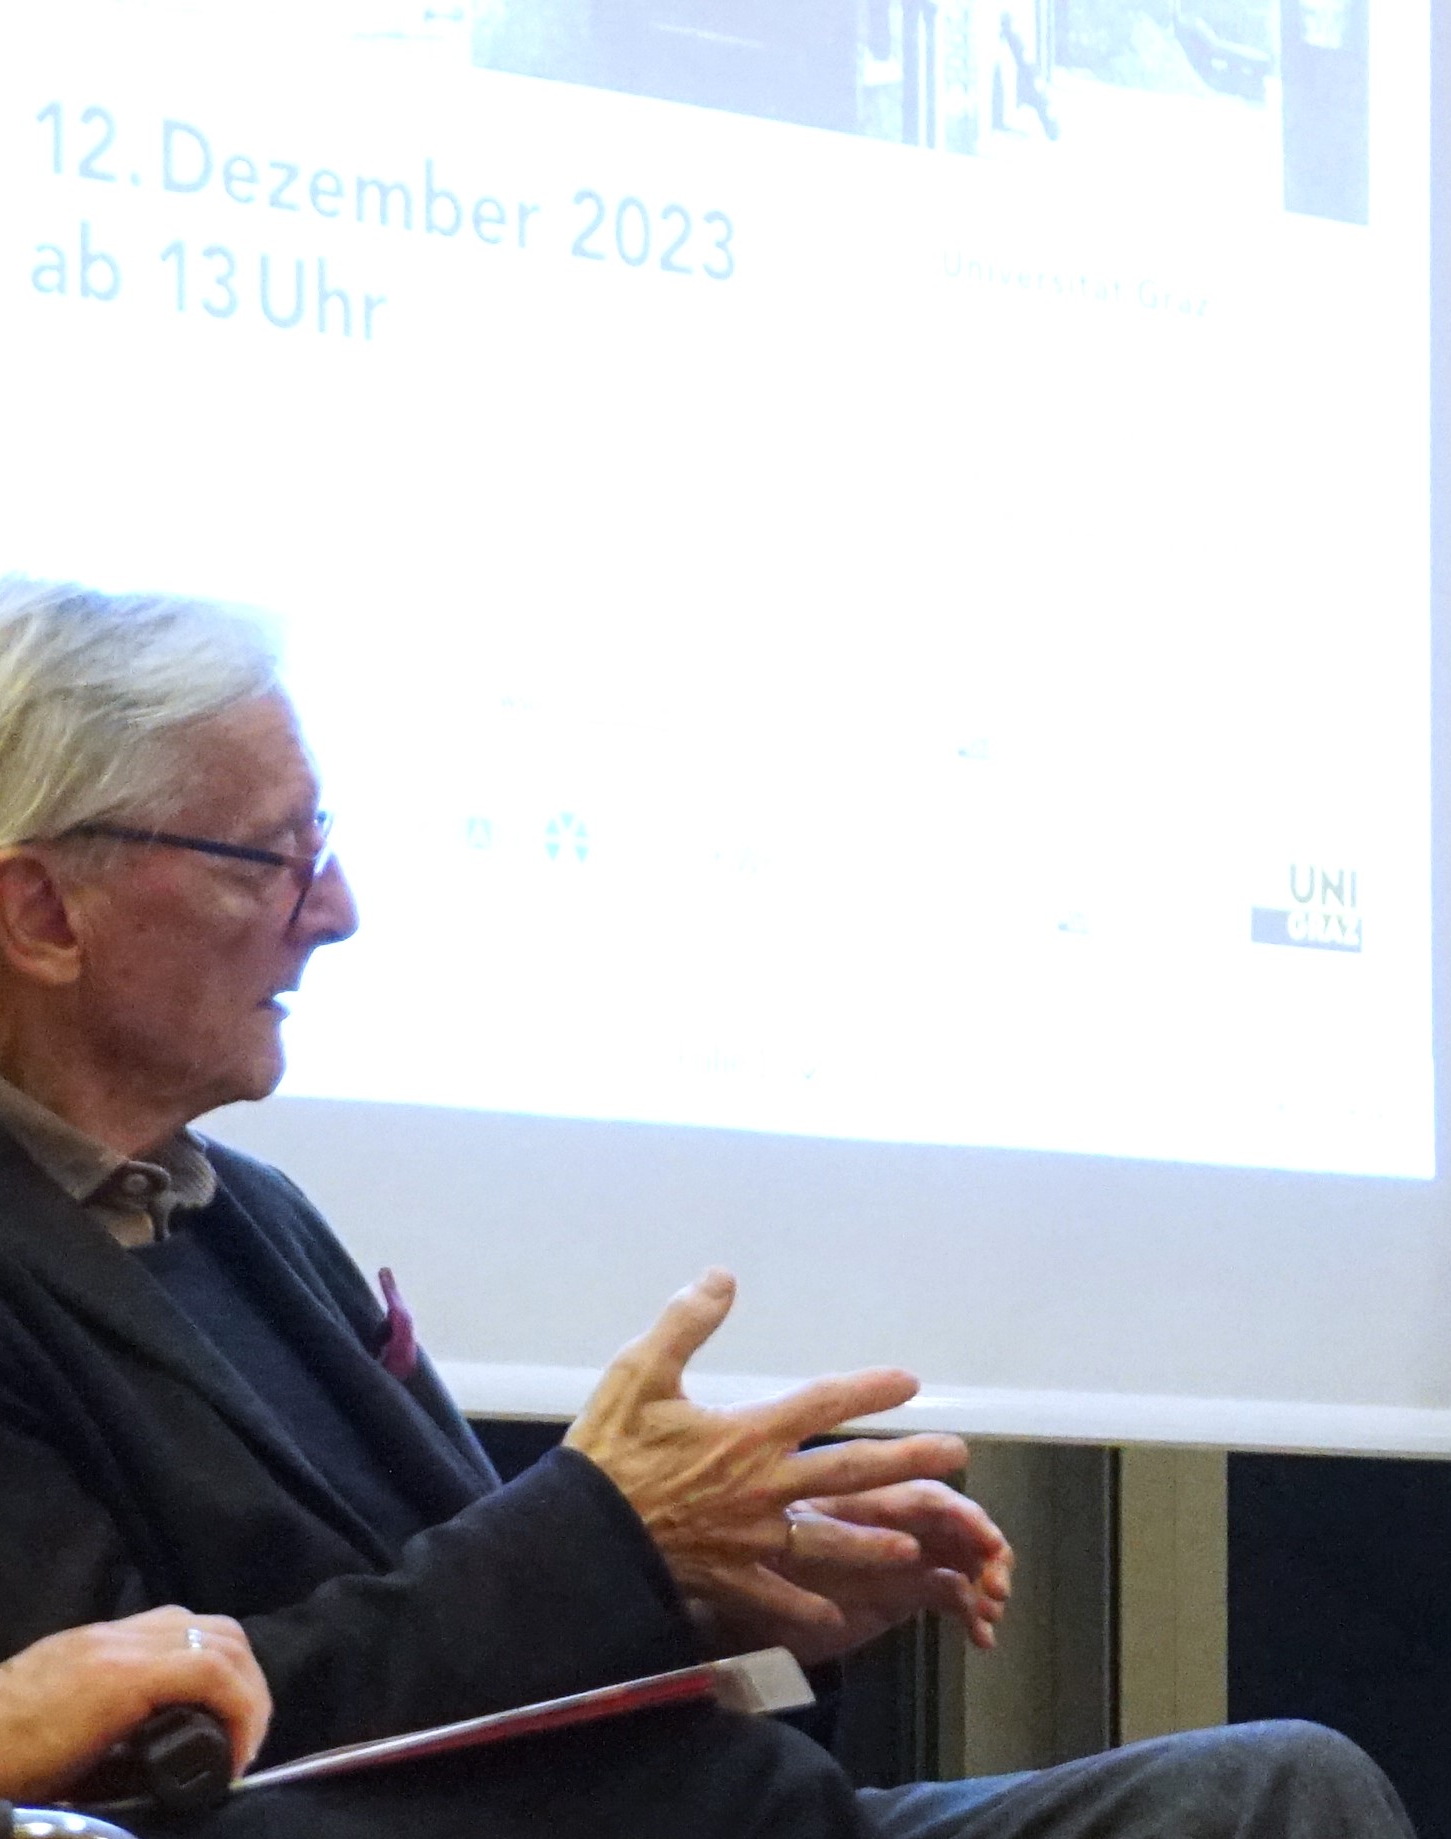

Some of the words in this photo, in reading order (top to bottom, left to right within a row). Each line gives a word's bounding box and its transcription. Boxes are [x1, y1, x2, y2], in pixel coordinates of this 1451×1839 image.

[159, 117, 542, 250] Dezember
[570, 188, 736, 282] 2023
[30, 218, 123, 303] ab
[1289, 863, 1357, 908] UNI
[1286, 911, 1360, 946] GRAZ
